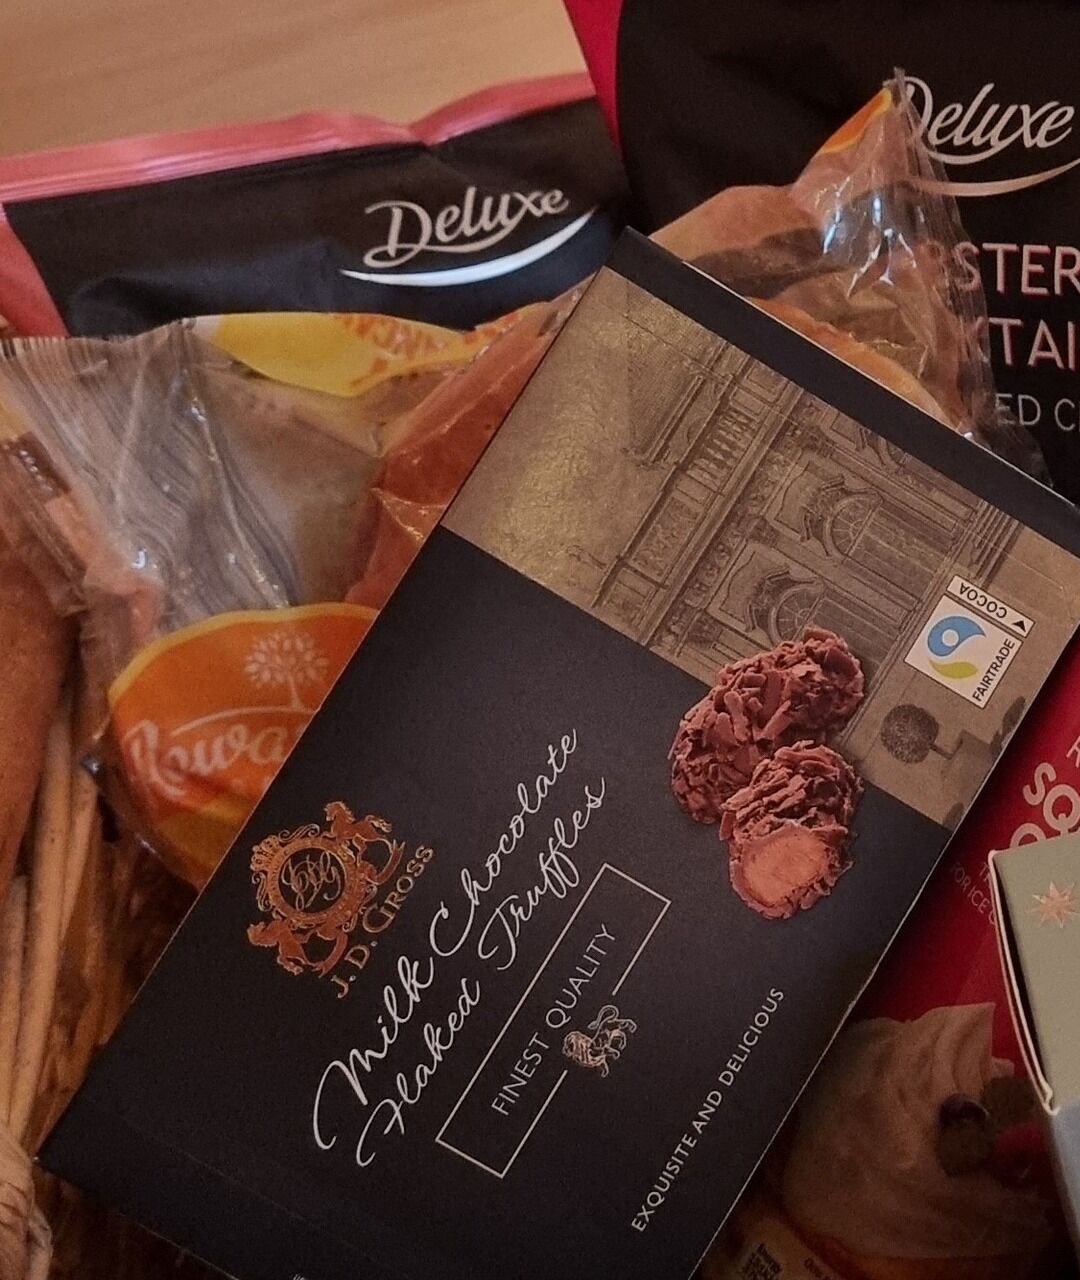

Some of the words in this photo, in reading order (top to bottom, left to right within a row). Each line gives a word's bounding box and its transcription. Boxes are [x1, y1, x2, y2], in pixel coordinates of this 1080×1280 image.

[883, 76, 1076, 166] Deluxe
[362, 185, 571, 268] Deluxe
[960, 582, 1008, 619] COCOA
[972, 638, 1016, 702] FAIRTRADE
[312, 956, 434, 1151] Milk
[429, 728, 578, 957] Chocolate
[967, 885, 990, 914] ICE
[355, 977, 481, 1167] Flaked
[477, 777, 606, 970] Truffles
[490, 1031, 551, 1116] FINEST
[545, 923, 616, 1029] QUALITY
[630, 1133, 698, 1233] EXQUISITE
[691, 1089, 722, 1134] AND
[717, 986, 785, 1086] DELICIOUS
